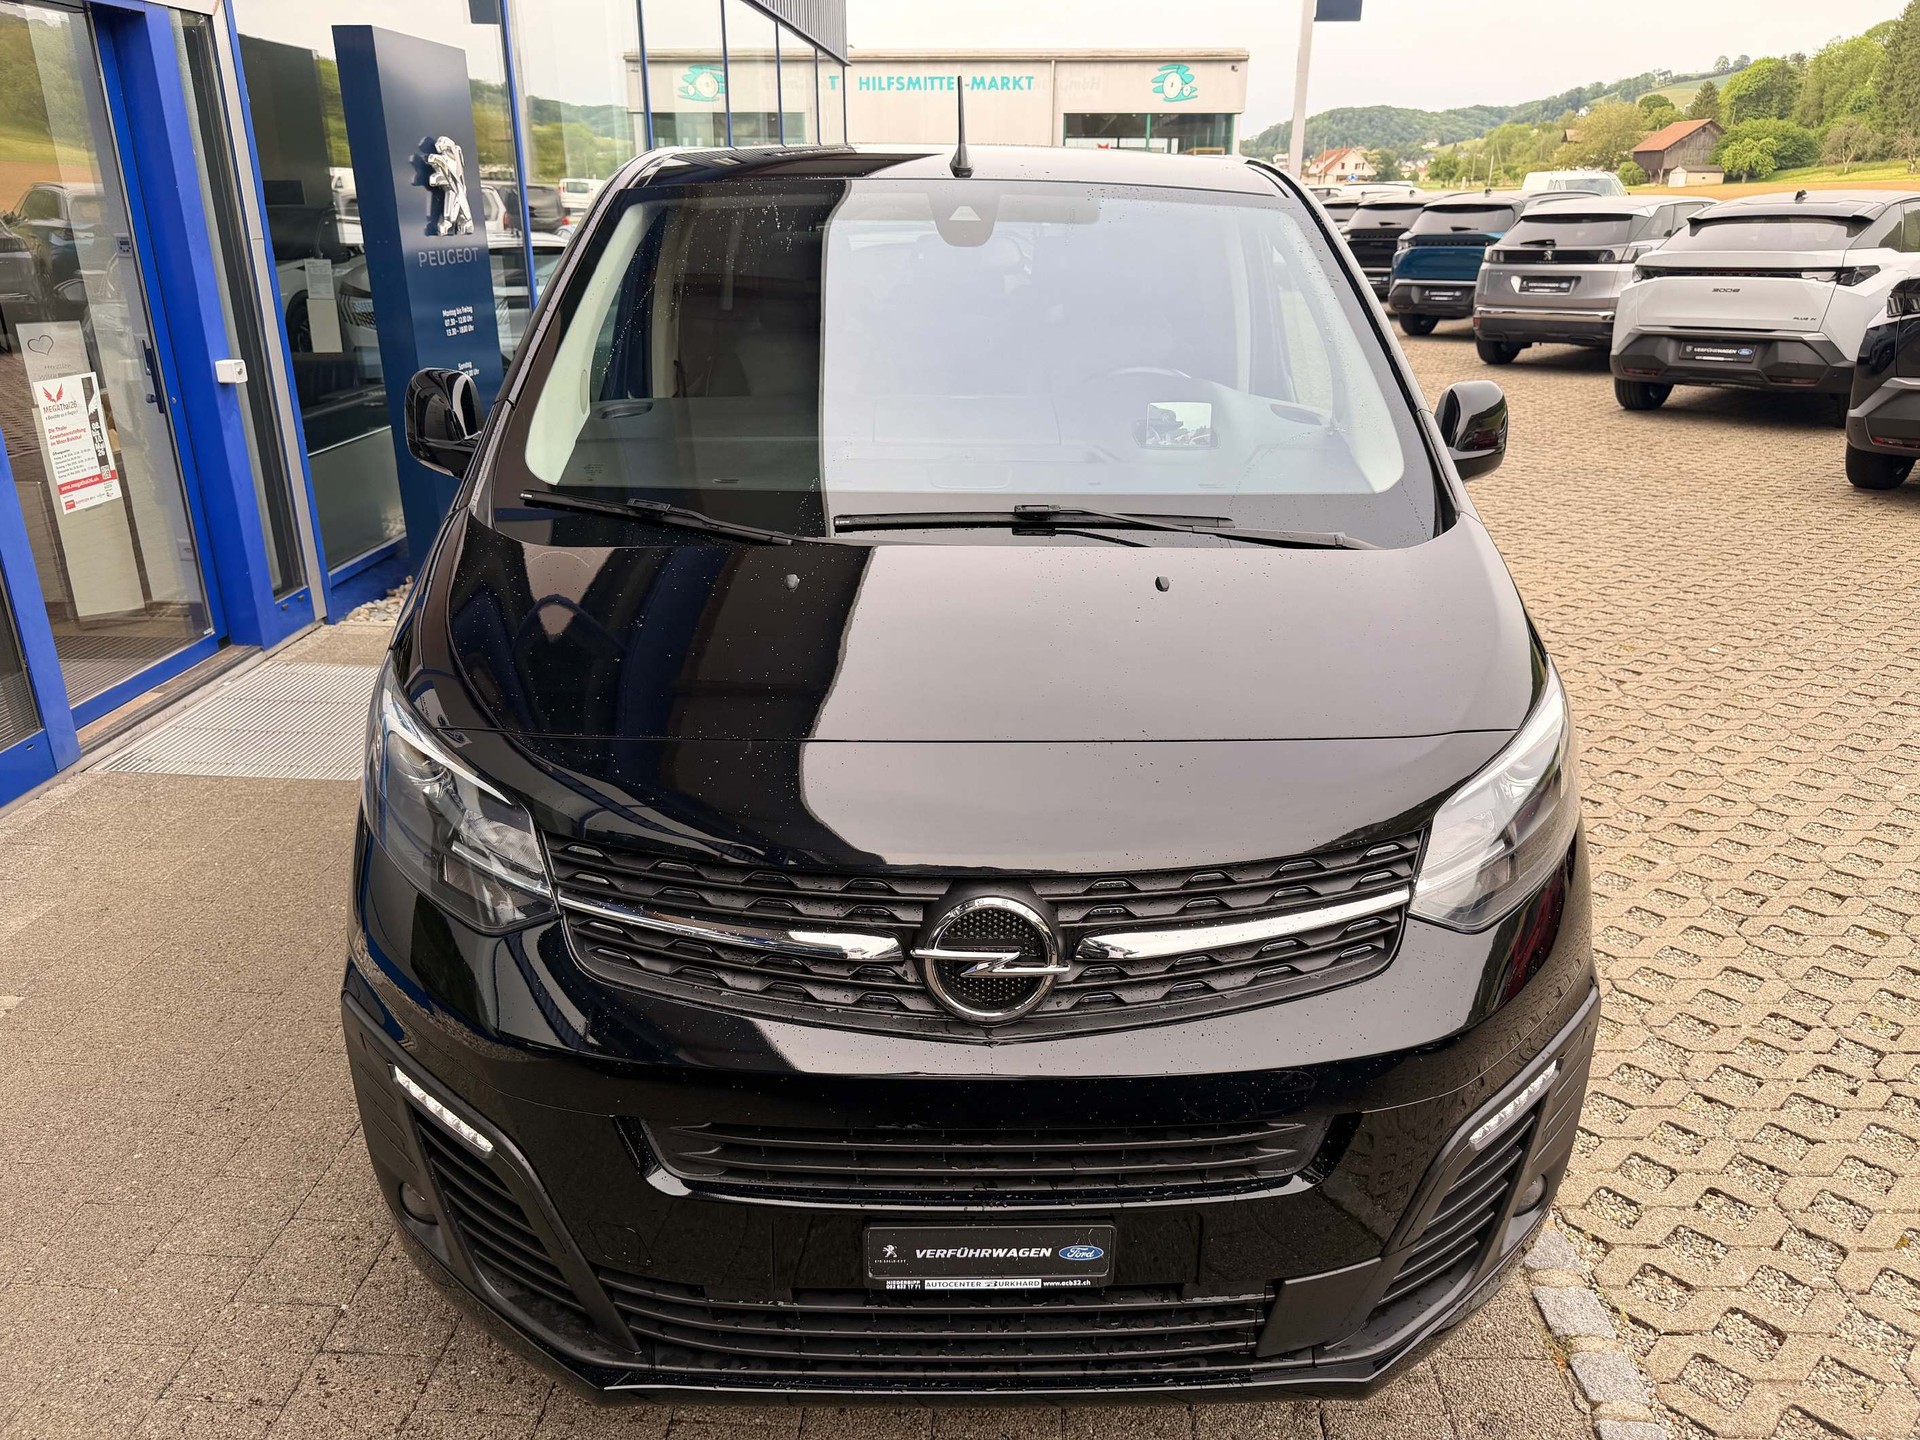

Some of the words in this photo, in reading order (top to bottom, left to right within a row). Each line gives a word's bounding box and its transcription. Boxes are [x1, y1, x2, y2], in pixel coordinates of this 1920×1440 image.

[858, 75, 1035, 91] HILFSMITTE-MARKT
[418, 247, 479, 267] PEUGEOT
[915, 1246, 1053, 1259] VERFÜHRWAGEN
